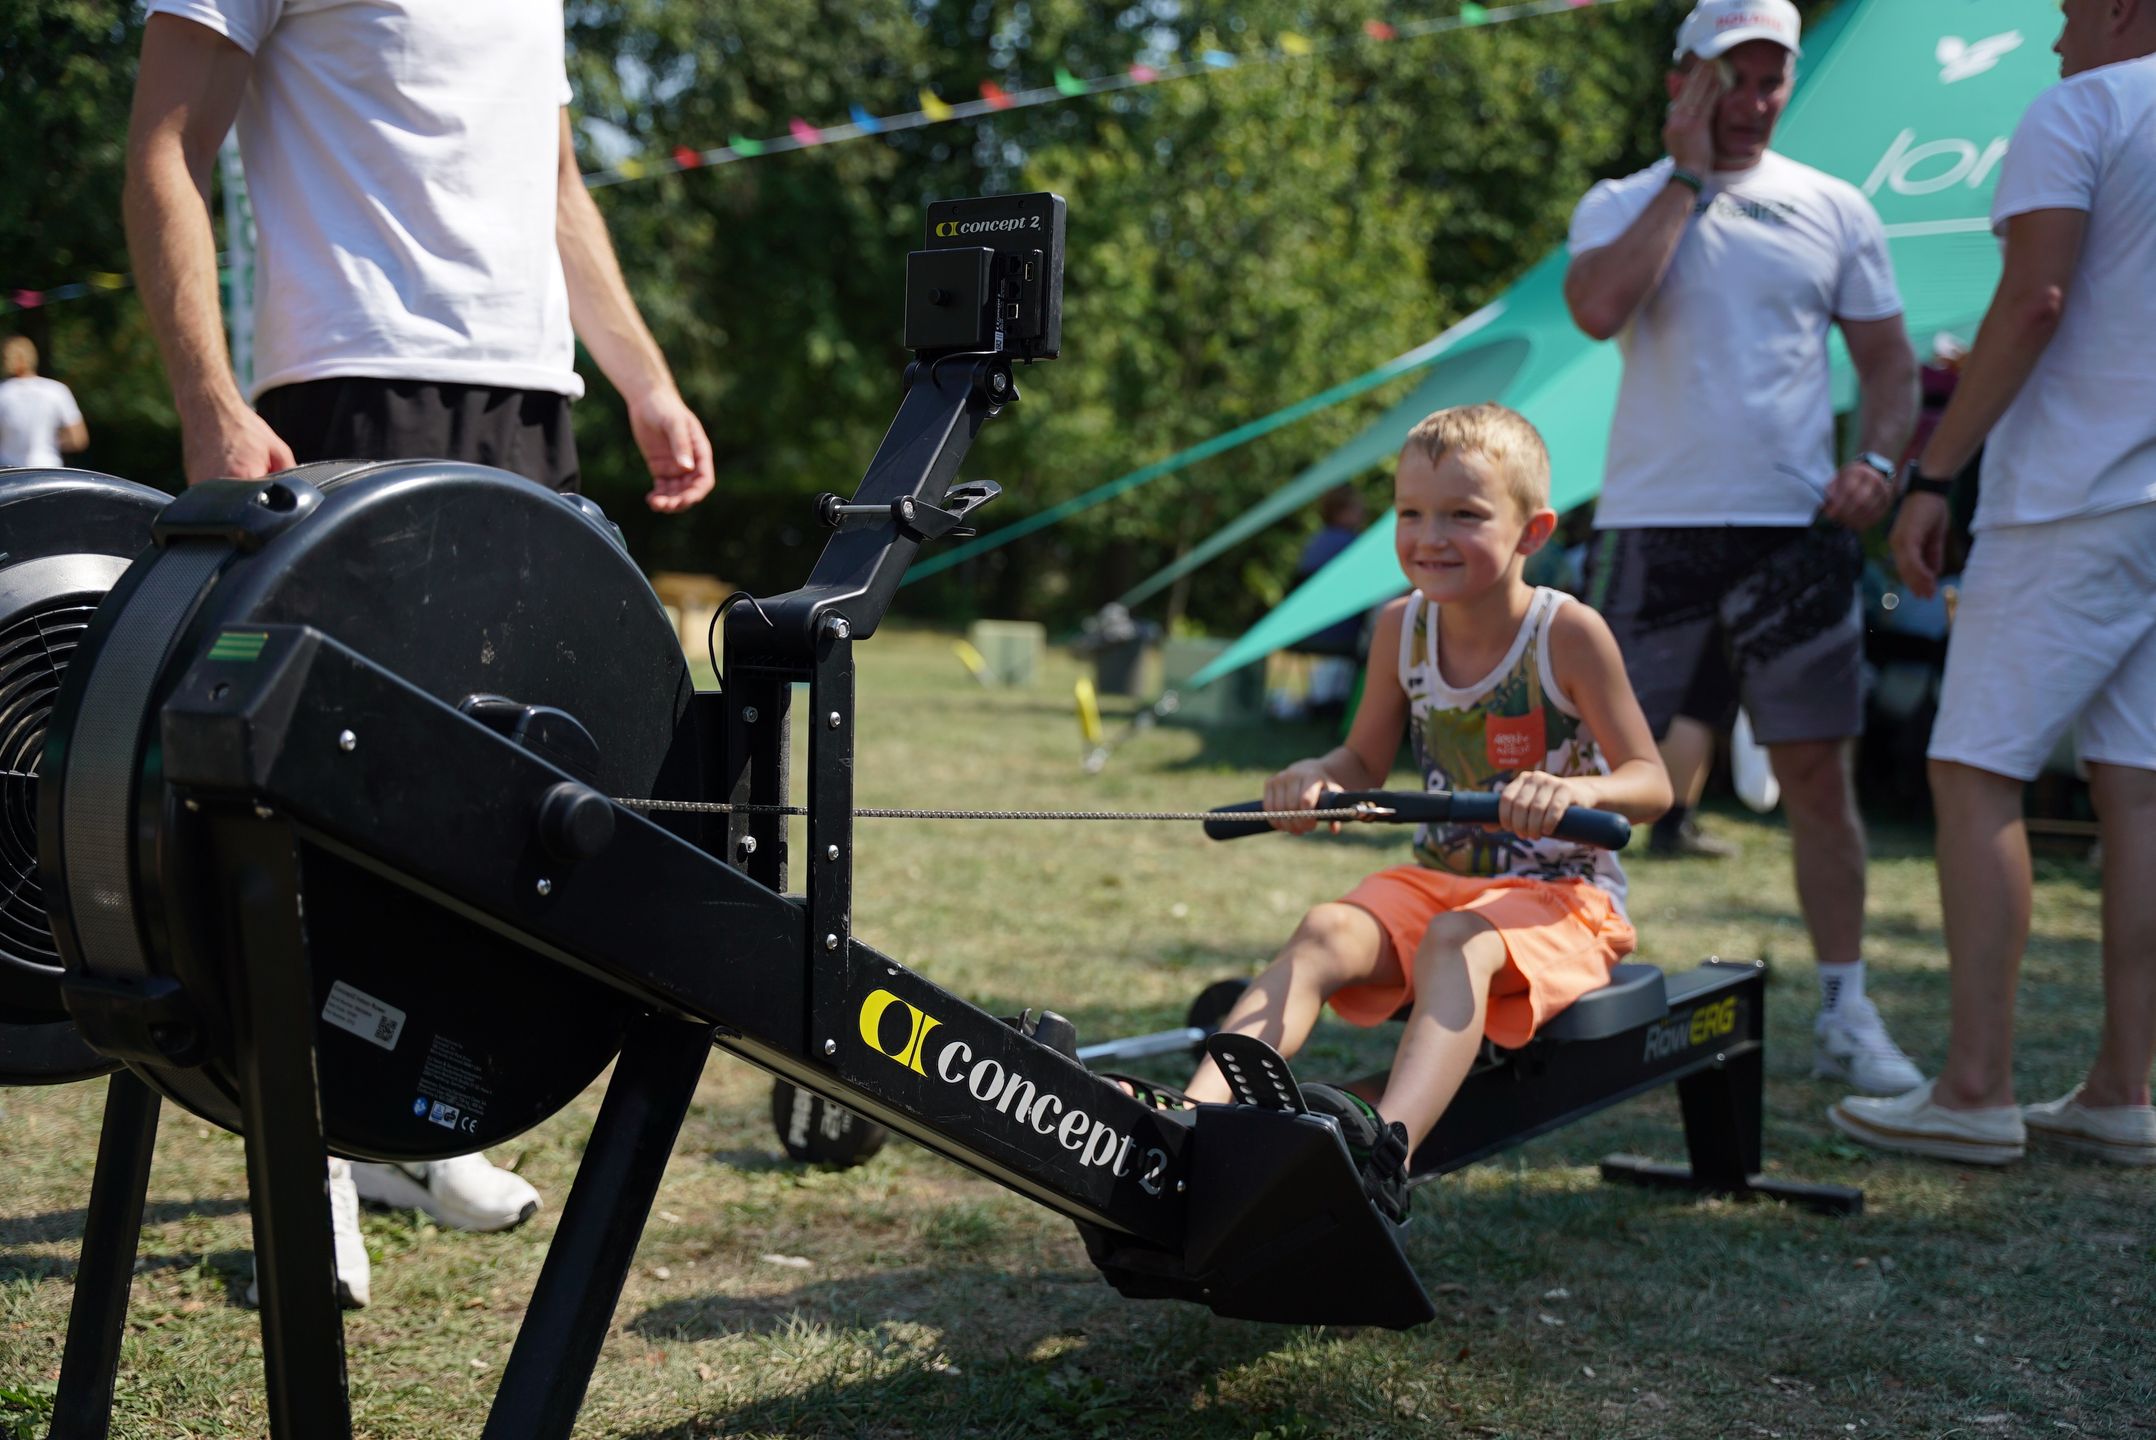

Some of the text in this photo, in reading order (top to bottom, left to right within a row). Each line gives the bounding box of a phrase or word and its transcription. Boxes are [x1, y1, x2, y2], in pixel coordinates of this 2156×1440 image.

[960, 215, 1041, 234] concept 2
[937, 1041, 1135, 1178] concept
[1138, 1148, 1168, 1195] 2
